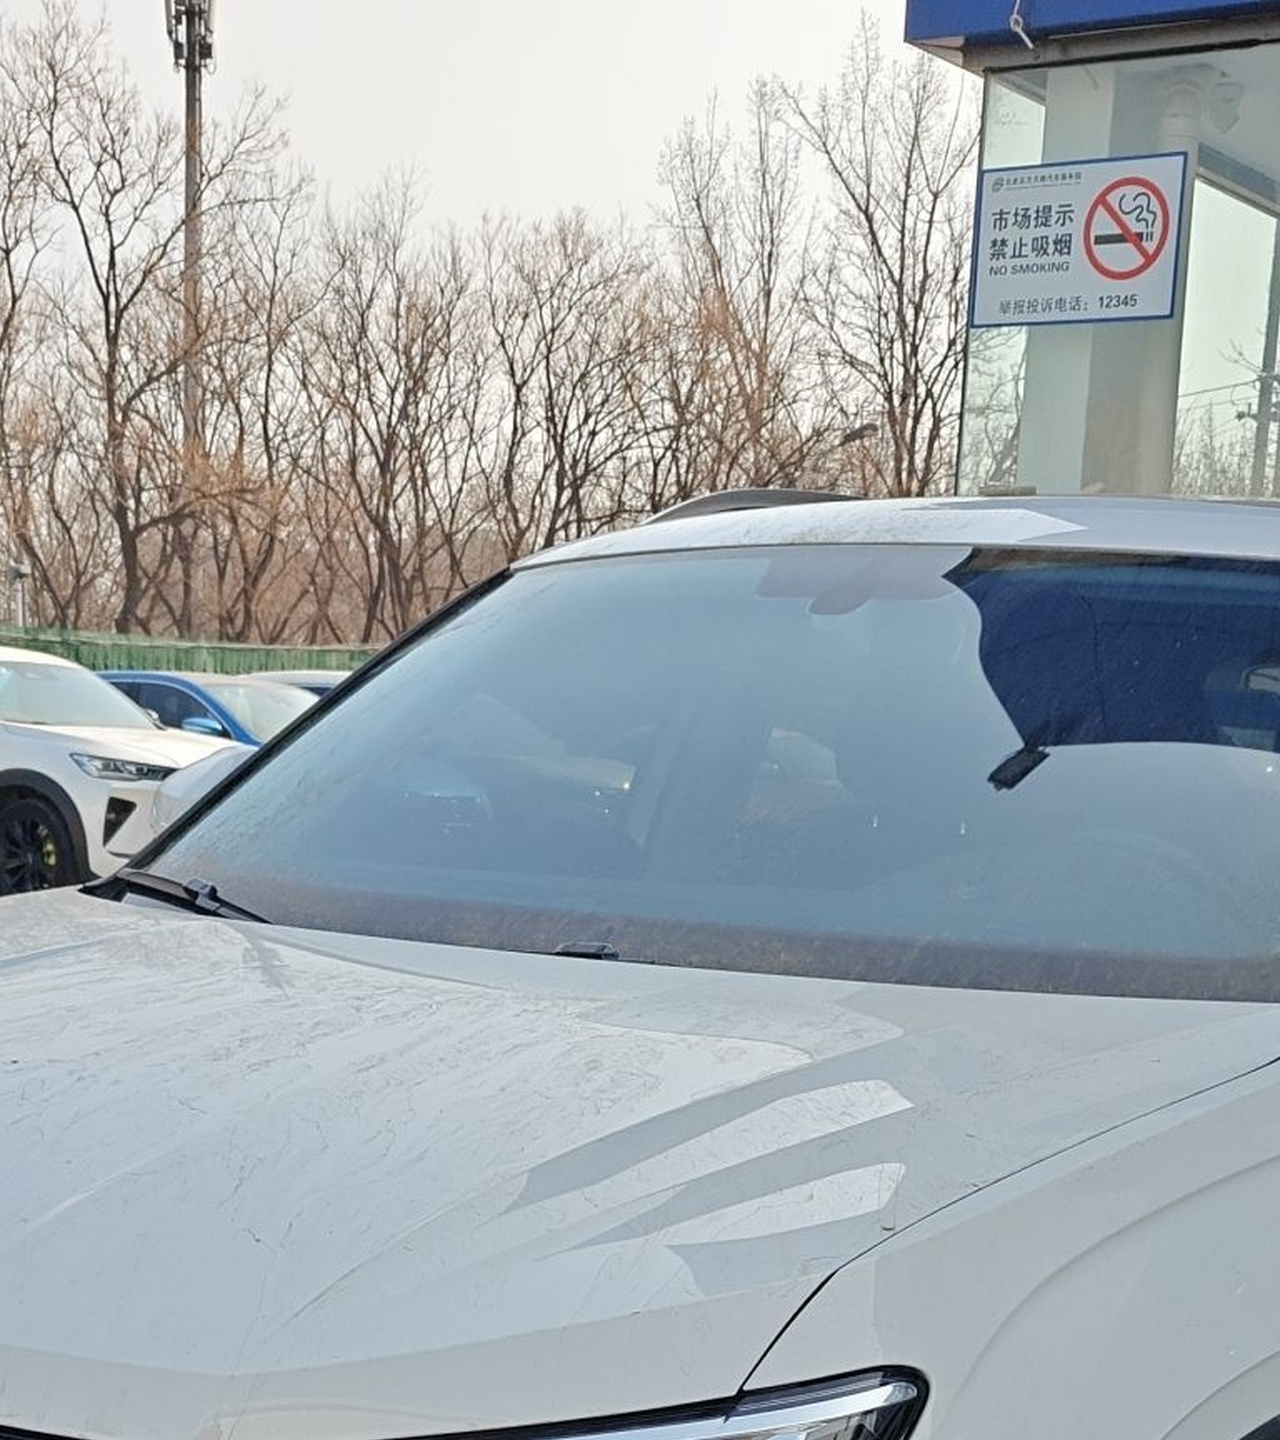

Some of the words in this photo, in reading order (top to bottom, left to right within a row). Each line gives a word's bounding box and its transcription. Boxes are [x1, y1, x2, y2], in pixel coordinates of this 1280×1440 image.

[991, 203, 1075, 232] 市场提示
[989, 232, 1073, 262] 禁止吸烟
[988, 264, 1008, 277] NO
[1010, 261, 1070, 275] SMOKING
[1097, 293, 1138, 309] 12345
